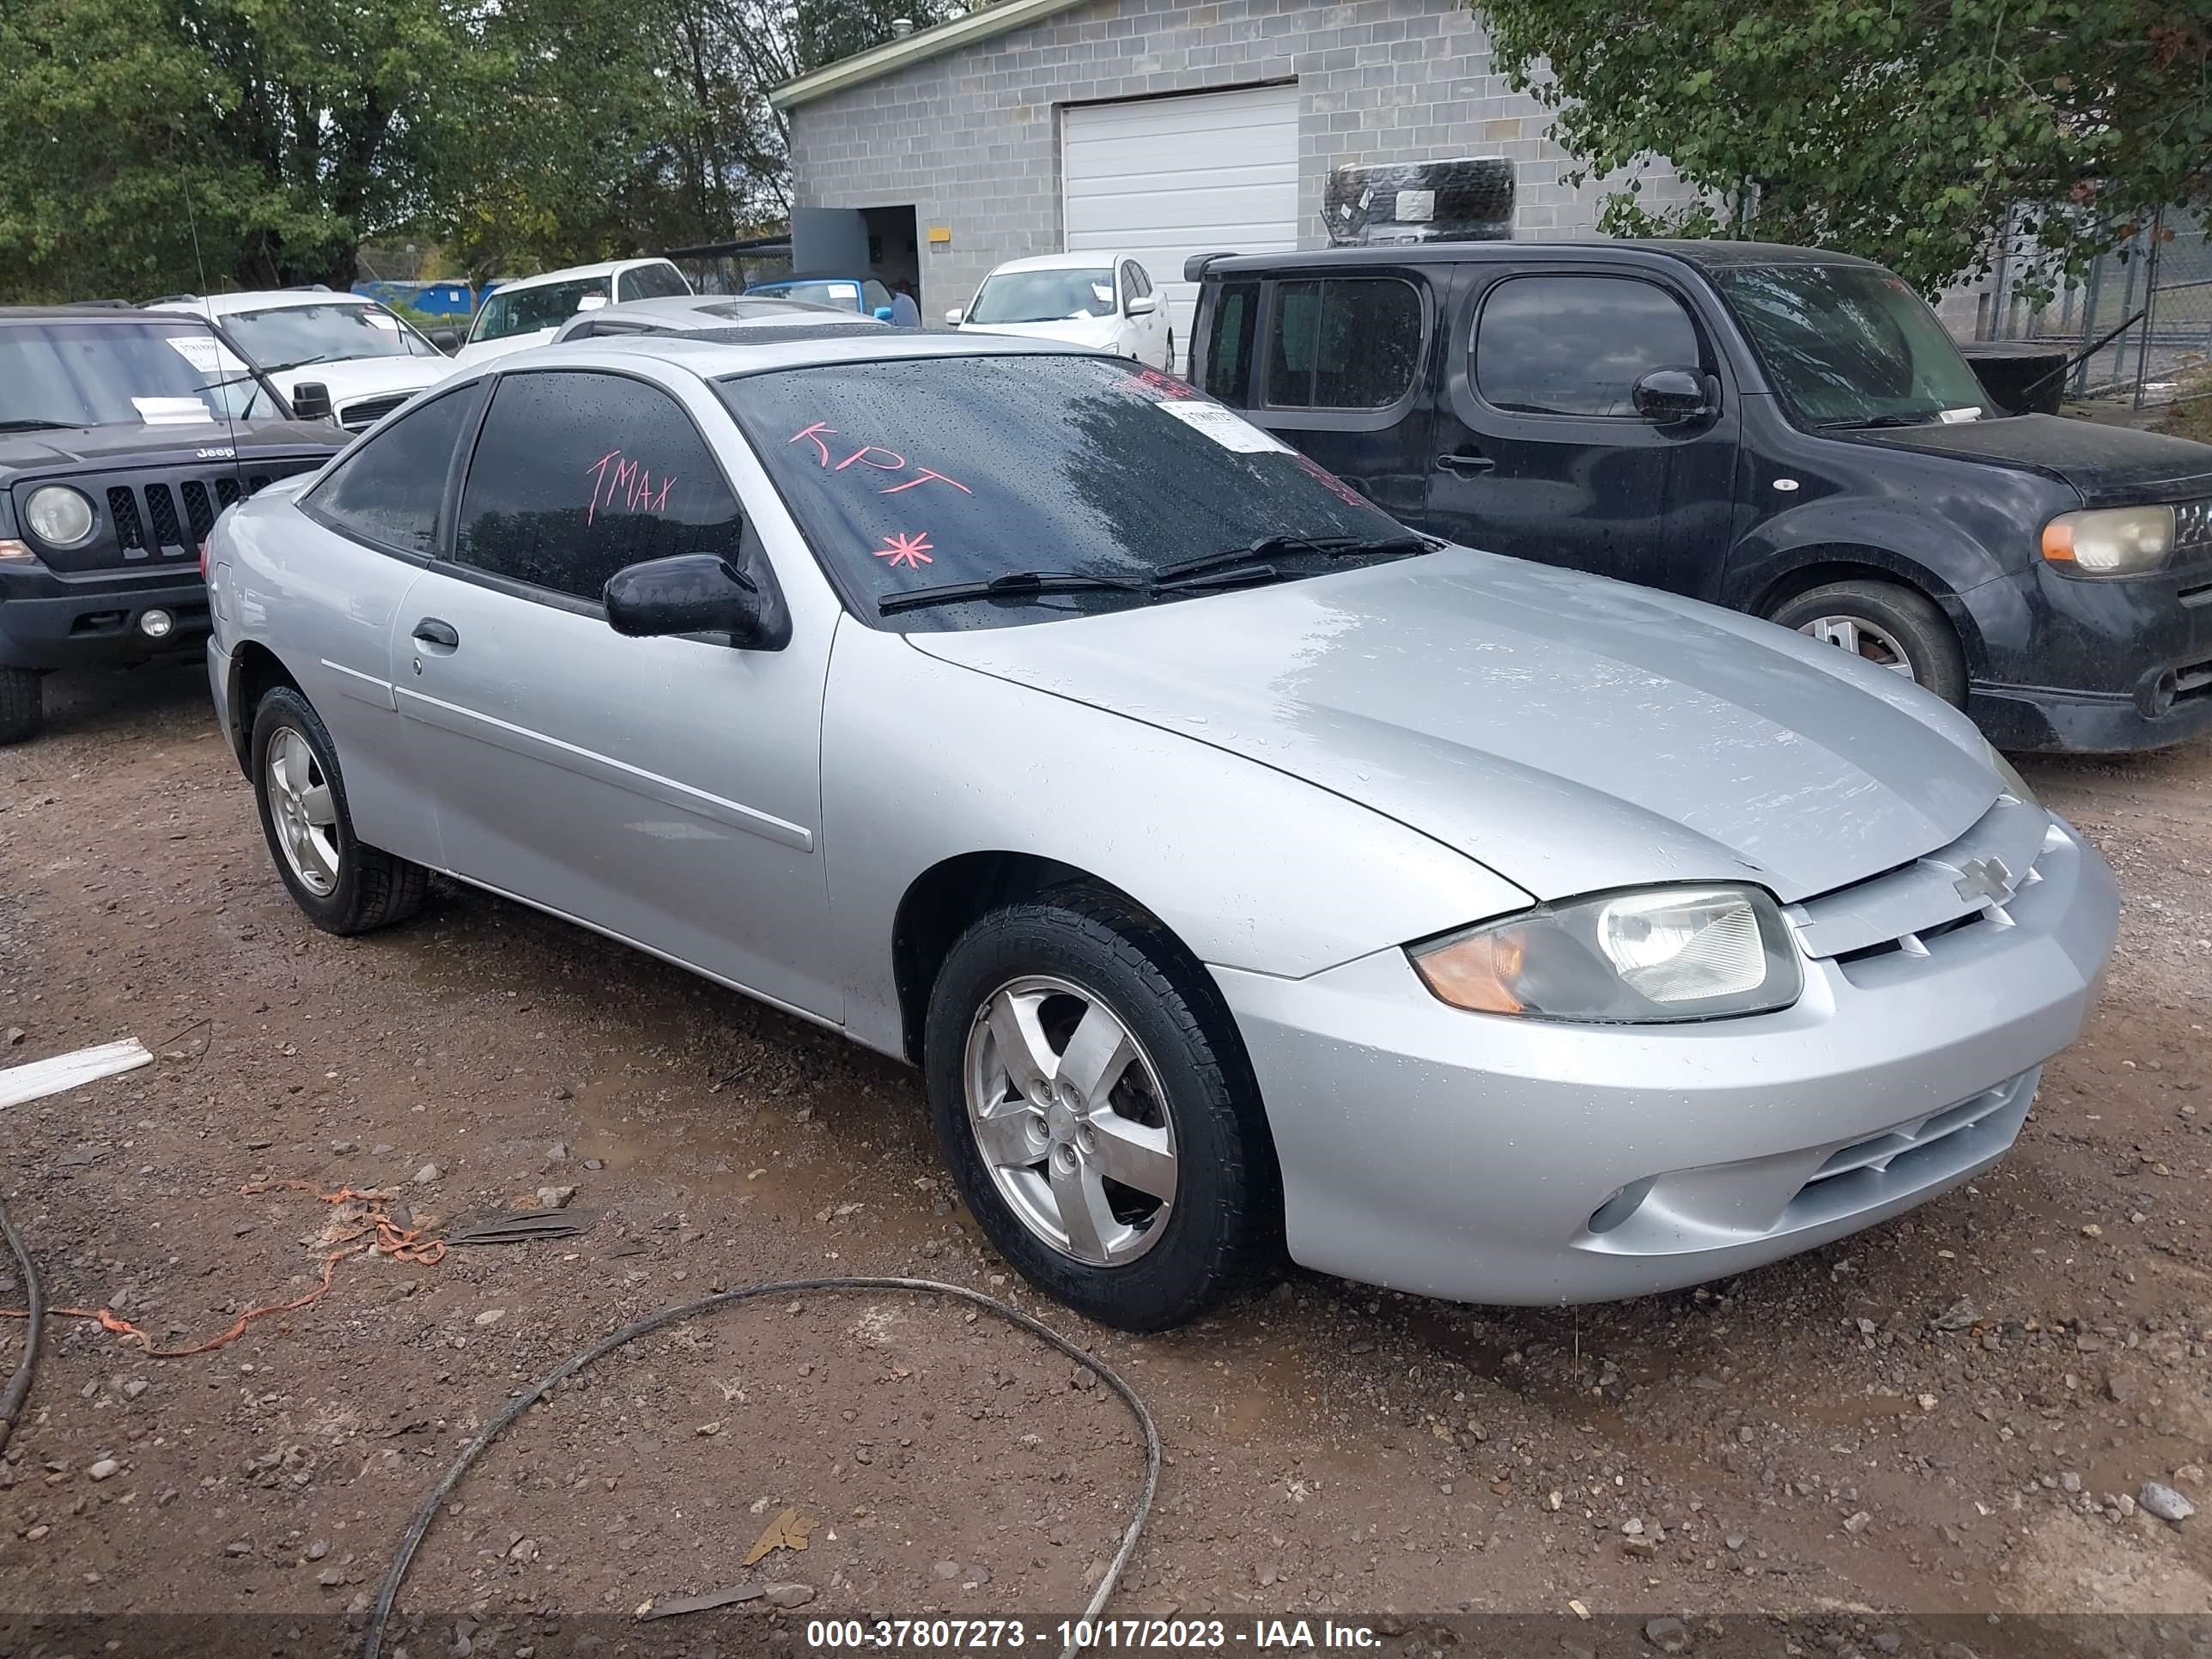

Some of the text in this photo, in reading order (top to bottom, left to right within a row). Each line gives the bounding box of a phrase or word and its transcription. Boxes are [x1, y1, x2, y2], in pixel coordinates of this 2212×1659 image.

[197, 447, 235, 458] Jeep
[586, 449, 678, 527] TMAX
[788, 421, 973, 494] KPT
